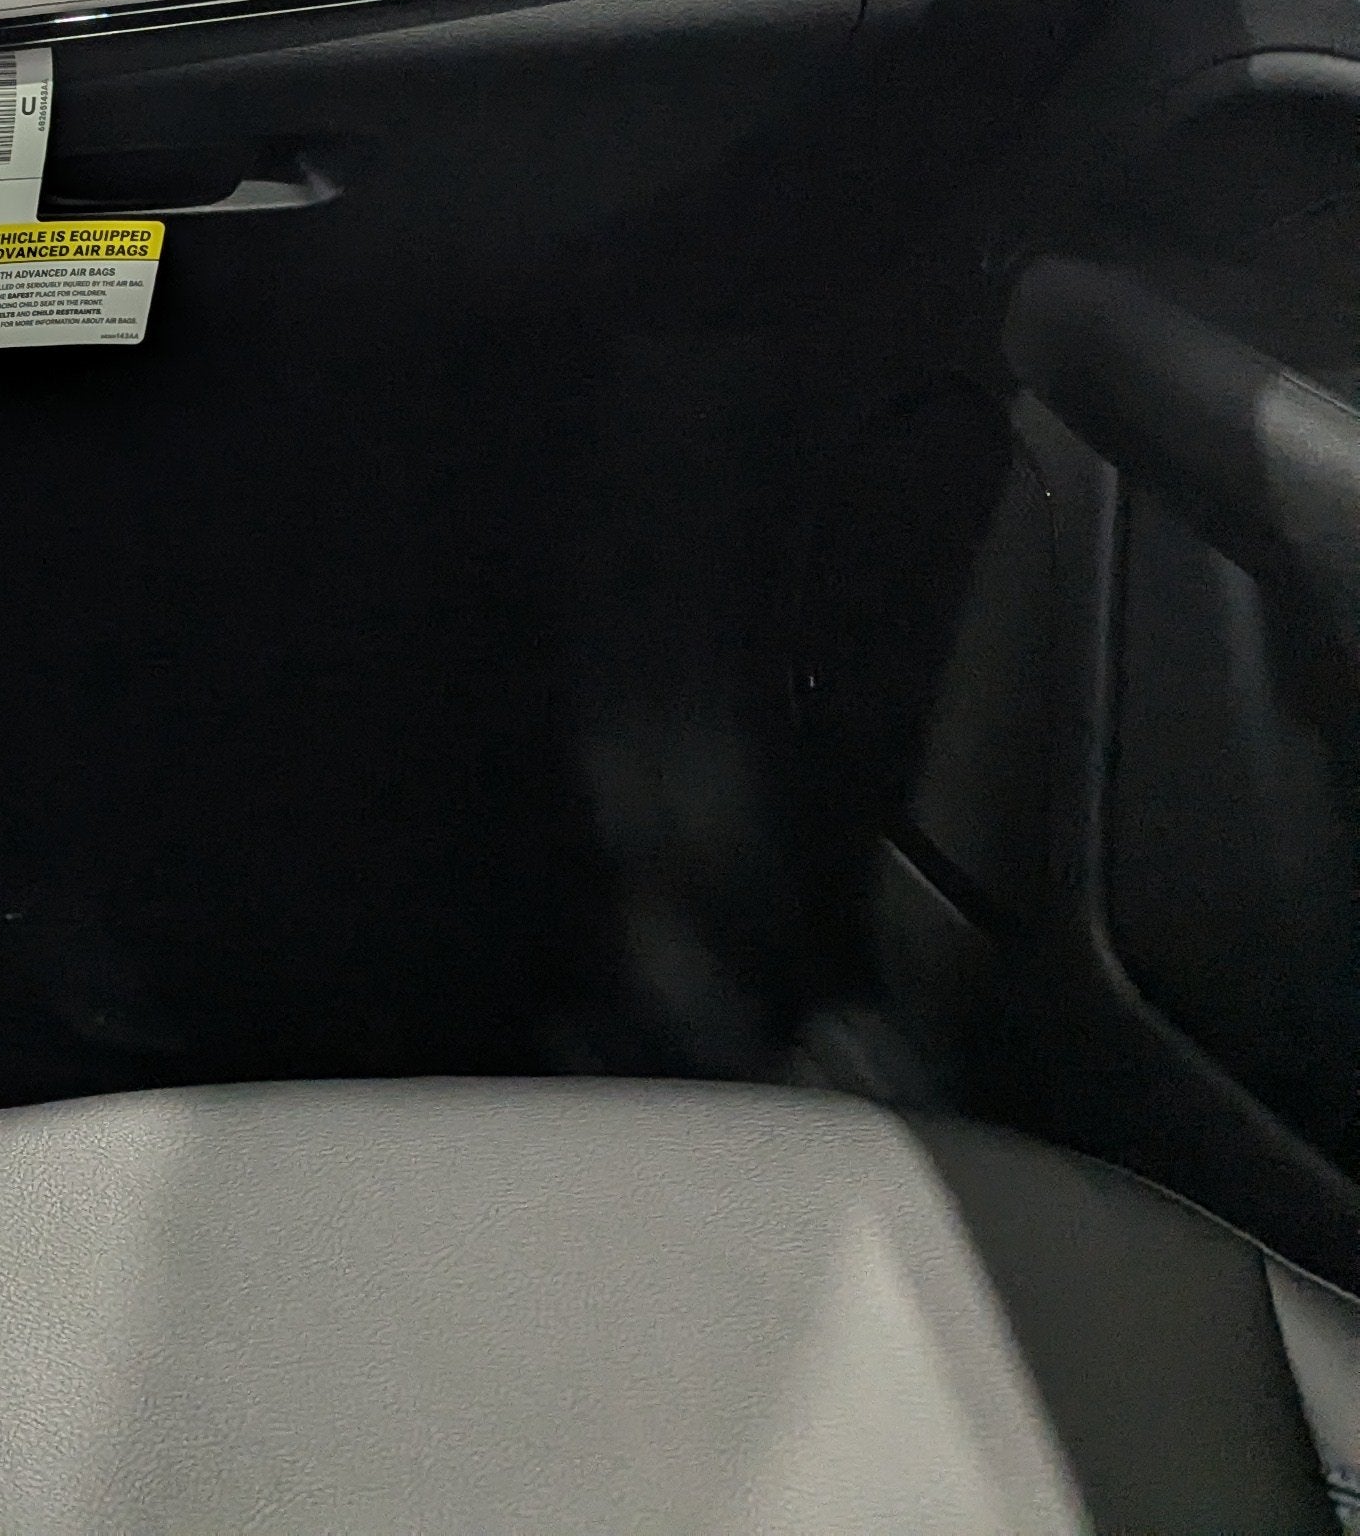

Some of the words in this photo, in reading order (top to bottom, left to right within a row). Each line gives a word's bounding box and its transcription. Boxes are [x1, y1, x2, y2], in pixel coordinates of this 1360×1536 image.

[22, 96, 36, 116] U
[50, 230, 66, 242] IS
[70, 230, 152, 242] EQUIPPED
[73, 244, 101, 256] AIR
[105, 244, 149, 256] BAGS
[14, 268, 68, 278] ADVANCED
[70, 268, 87, 277] AIR
[89, 268, 116, 276] BAGS
[8, 292, 34, 300] SAFEST
[35, 318, 80, 326] INFORMATION
